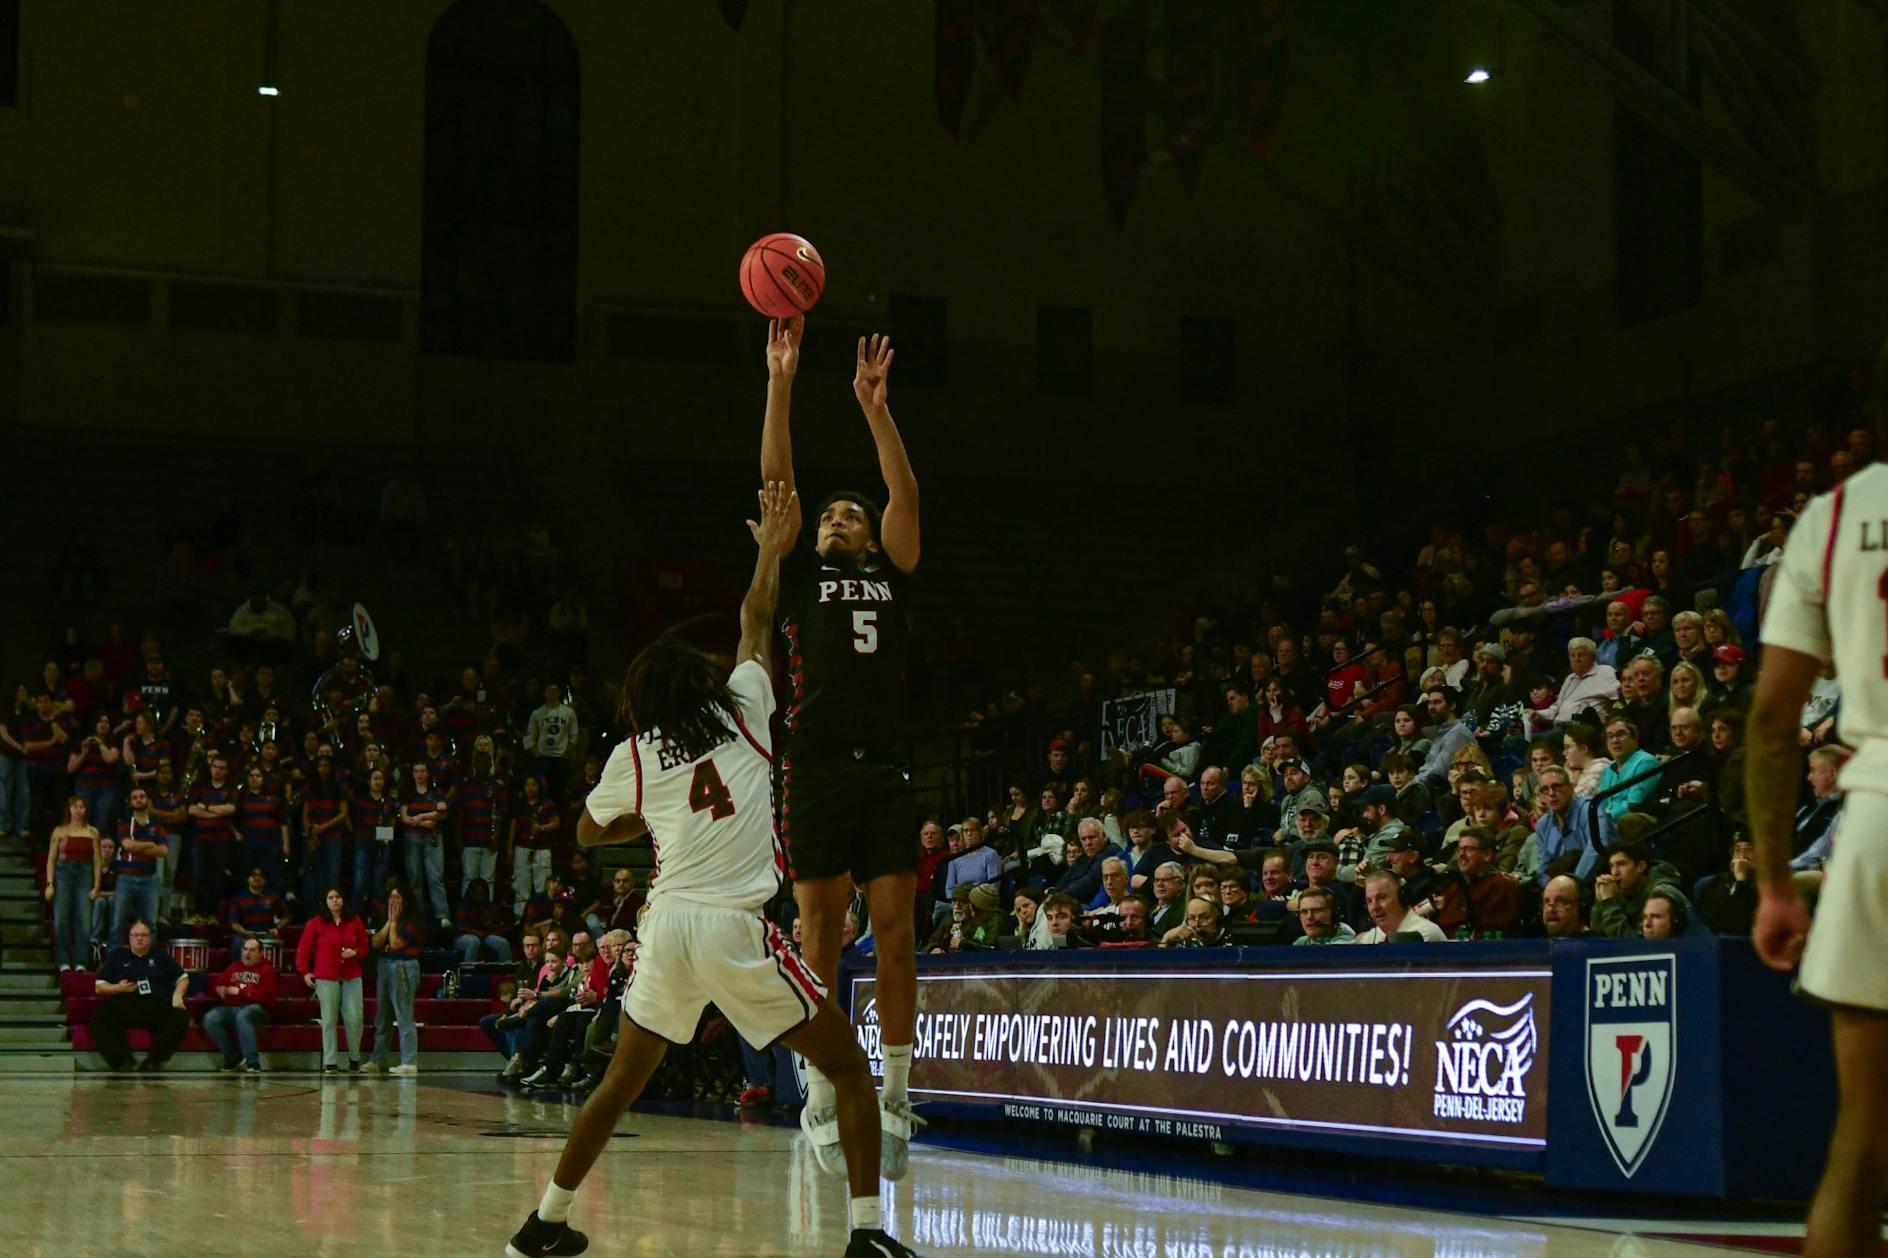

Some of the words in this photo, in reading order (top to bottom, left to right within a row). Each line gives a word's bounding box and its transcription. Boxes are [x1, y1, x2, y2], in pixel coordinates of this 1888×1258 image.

[782, 265, 815, 302] ELITE
[818, 579, 893, 603] PENN
[851, 609, 878, 654] 5
[688, 758, 736, 822] 4
[1594, 970, 1668, 1009] PENN
[914, 1013, 970, 1060] SAFELY
[973, 1013, 1096, 1068] EMPOWERING
[1103, 1016, 1159, 1072] LIVES
[1164, 1018, 1214, 1074] AND
[1222, 1018, 1413, 1087] COMMUNITIES!
[1434, 1040, 1527, 1097] NECA
[1615, 1034, 1651, 1128] P
[1004, 1103, 1040, 1120] WELCOME
[1043, 1107, 1054, 1121] TO
[1057, 1109, 1104, 1127] MACQUARIE
[1107, 1114, 1135, 1131] COURT
[1138, 1118, 1151, 1133] AT
[1154, 1119, 1172, 1135] THE
[1176, 1120, 1222, 1140] PALESTRA
[1433, 1093, 1525, 1123] PENN-DEL-JERSEY
